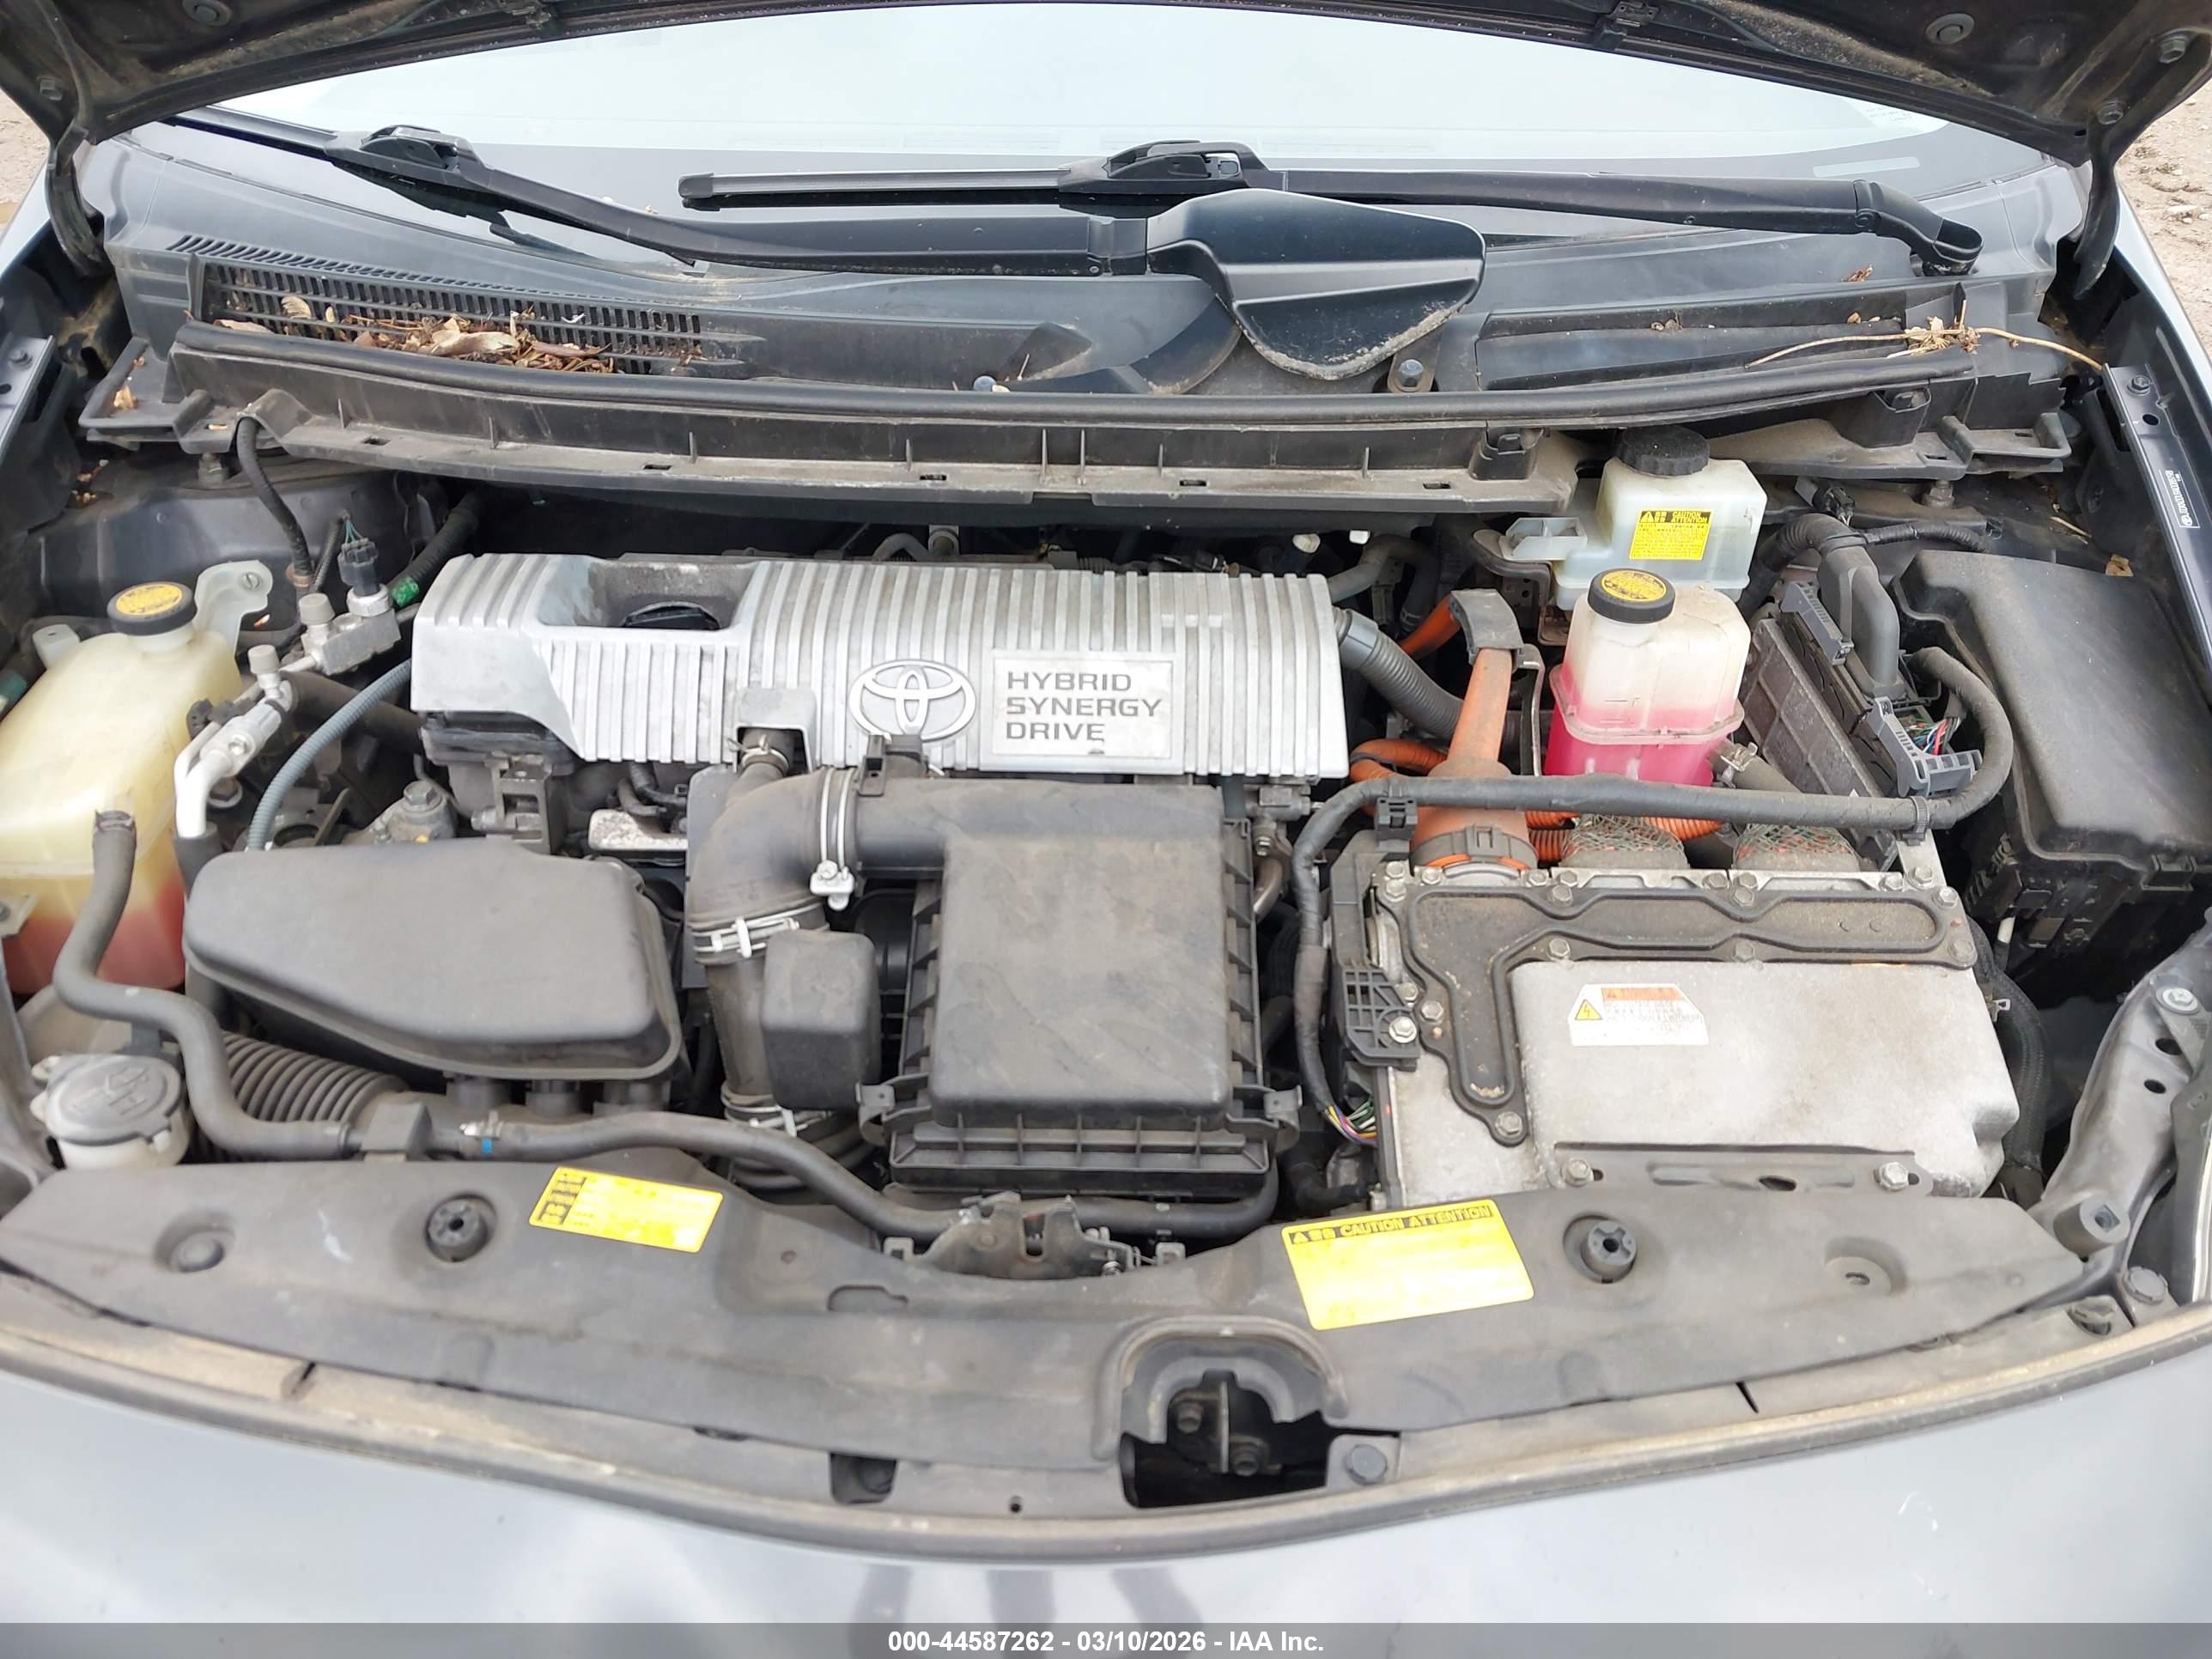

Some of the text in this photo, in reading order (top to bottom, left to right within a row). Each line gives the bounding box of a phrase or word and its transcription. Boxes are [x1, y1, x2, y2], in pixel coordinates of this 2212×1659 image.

[1007, 671, 1133, 692] HYBRID
[1006, 696, 1163, 718] SYNERGY
[1006, 722, 1105, 742] DRIVE
[1340, 1218, 1405, 1237] CAUTION
[1408, 1205, 1493, 1228] ATTENTION
